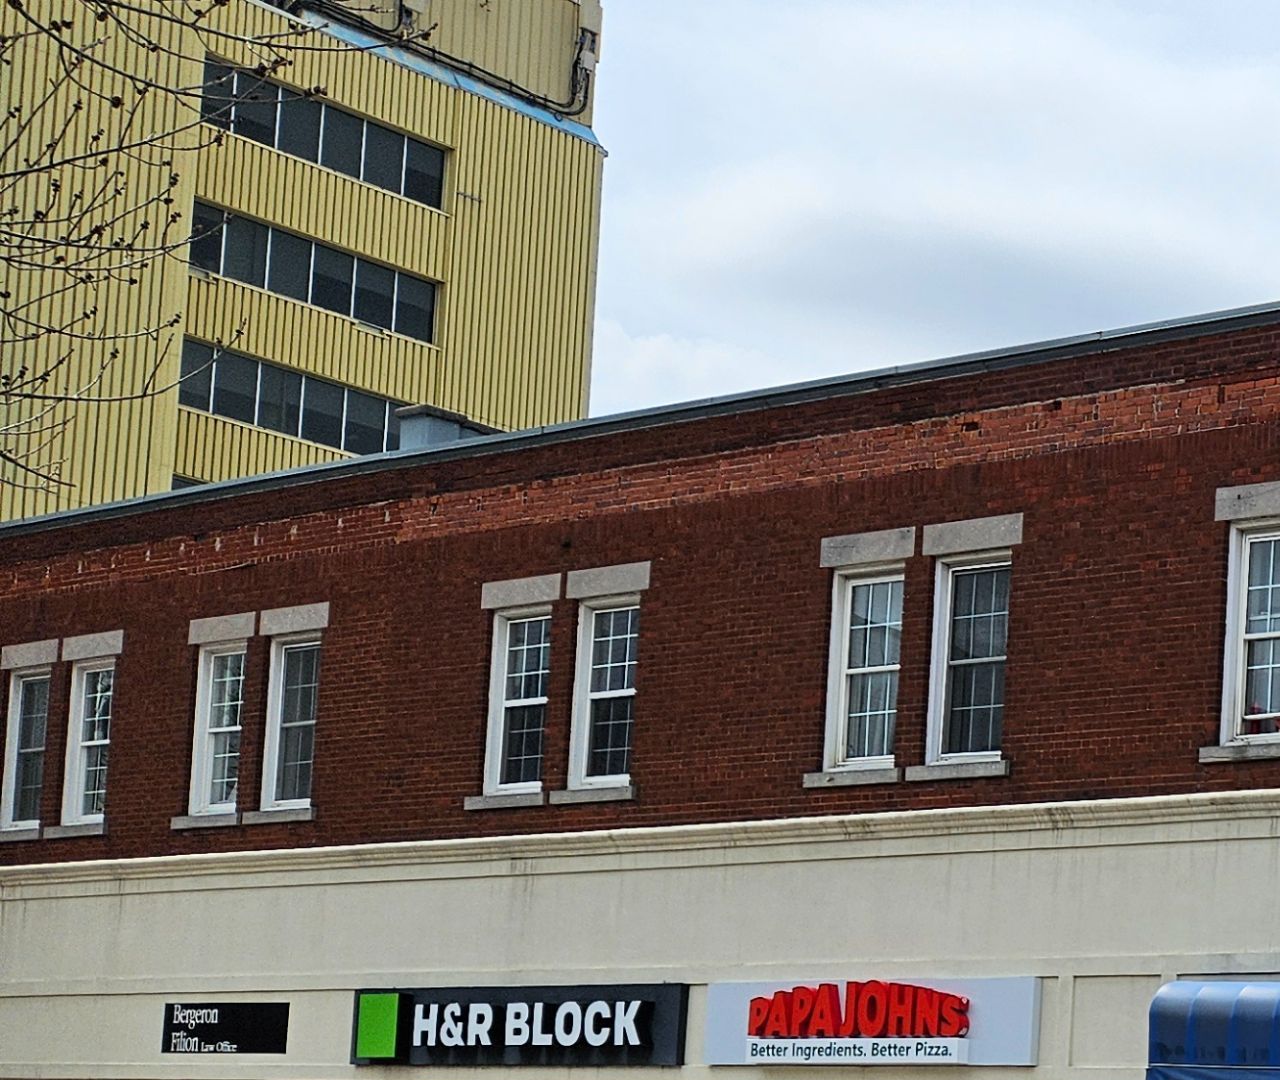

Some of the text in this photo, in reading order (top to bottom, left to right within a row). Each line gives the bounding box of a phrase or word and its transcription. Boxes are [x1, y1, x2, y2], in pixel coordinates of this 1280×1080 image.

[173, 1004, 219, 1030] Bergeron
[748, 979, 969, 1038] PAPA JOHNS
[413, 1000, 641, 1046] H&R BLOCK
[170, 1031, 199, 1052] Filion
[750, 1042, 953, 1061] Better Ingredients. Better Pizza.
